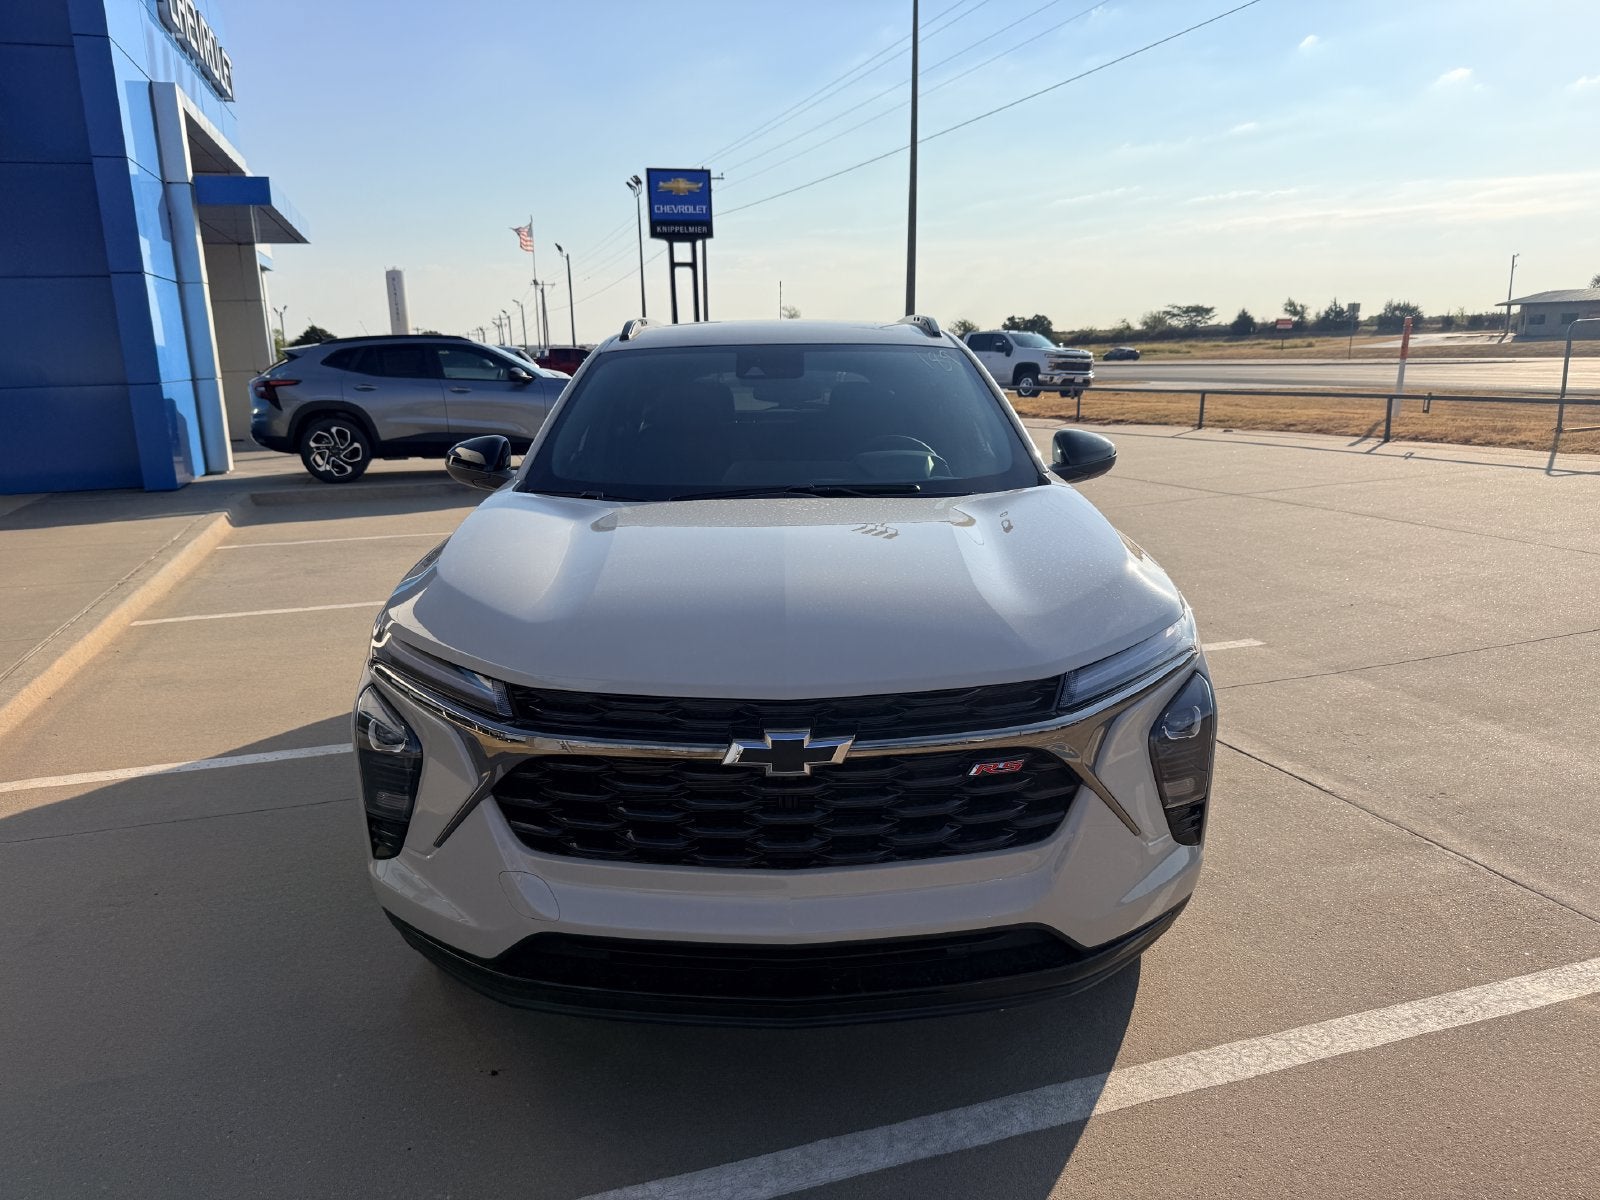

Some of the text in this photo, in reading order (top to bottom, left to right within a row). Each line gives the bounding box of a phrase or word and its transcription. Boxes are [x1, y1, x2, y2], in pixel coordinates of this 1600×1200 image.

[654, 204, 707, 214] CHEVROLET
[656, 225, 708, 233] KNIPPELMIER
[968, 759, 1025, 776] RS
